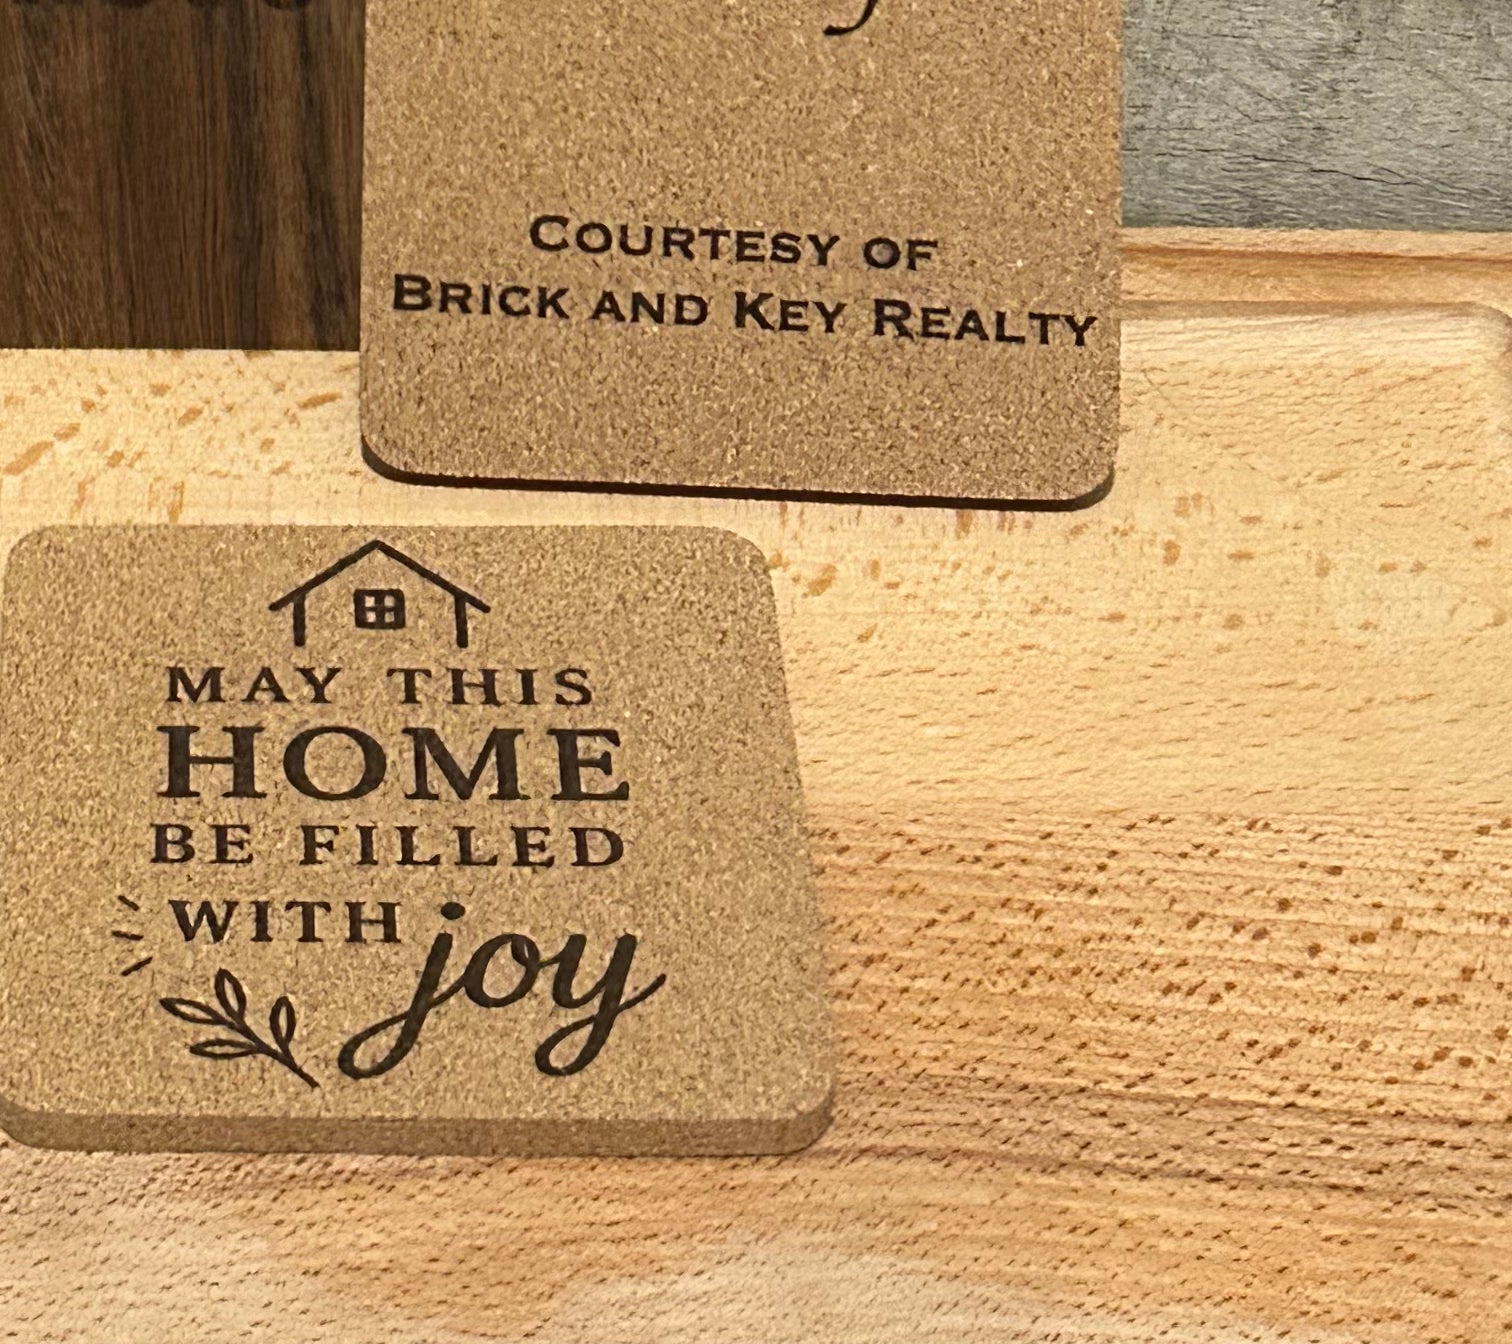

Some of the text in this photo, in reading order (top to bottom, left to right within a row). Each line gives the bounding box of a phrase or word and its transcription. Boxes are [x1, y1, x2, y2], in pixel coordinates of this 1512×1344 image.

[165, 666, 594, 707] MAY THIS
[155, 724, 631, 802] HOME
[149, 823, 624, 867] BE FILLED
[168, 899, 667, 1080] WITH joy
